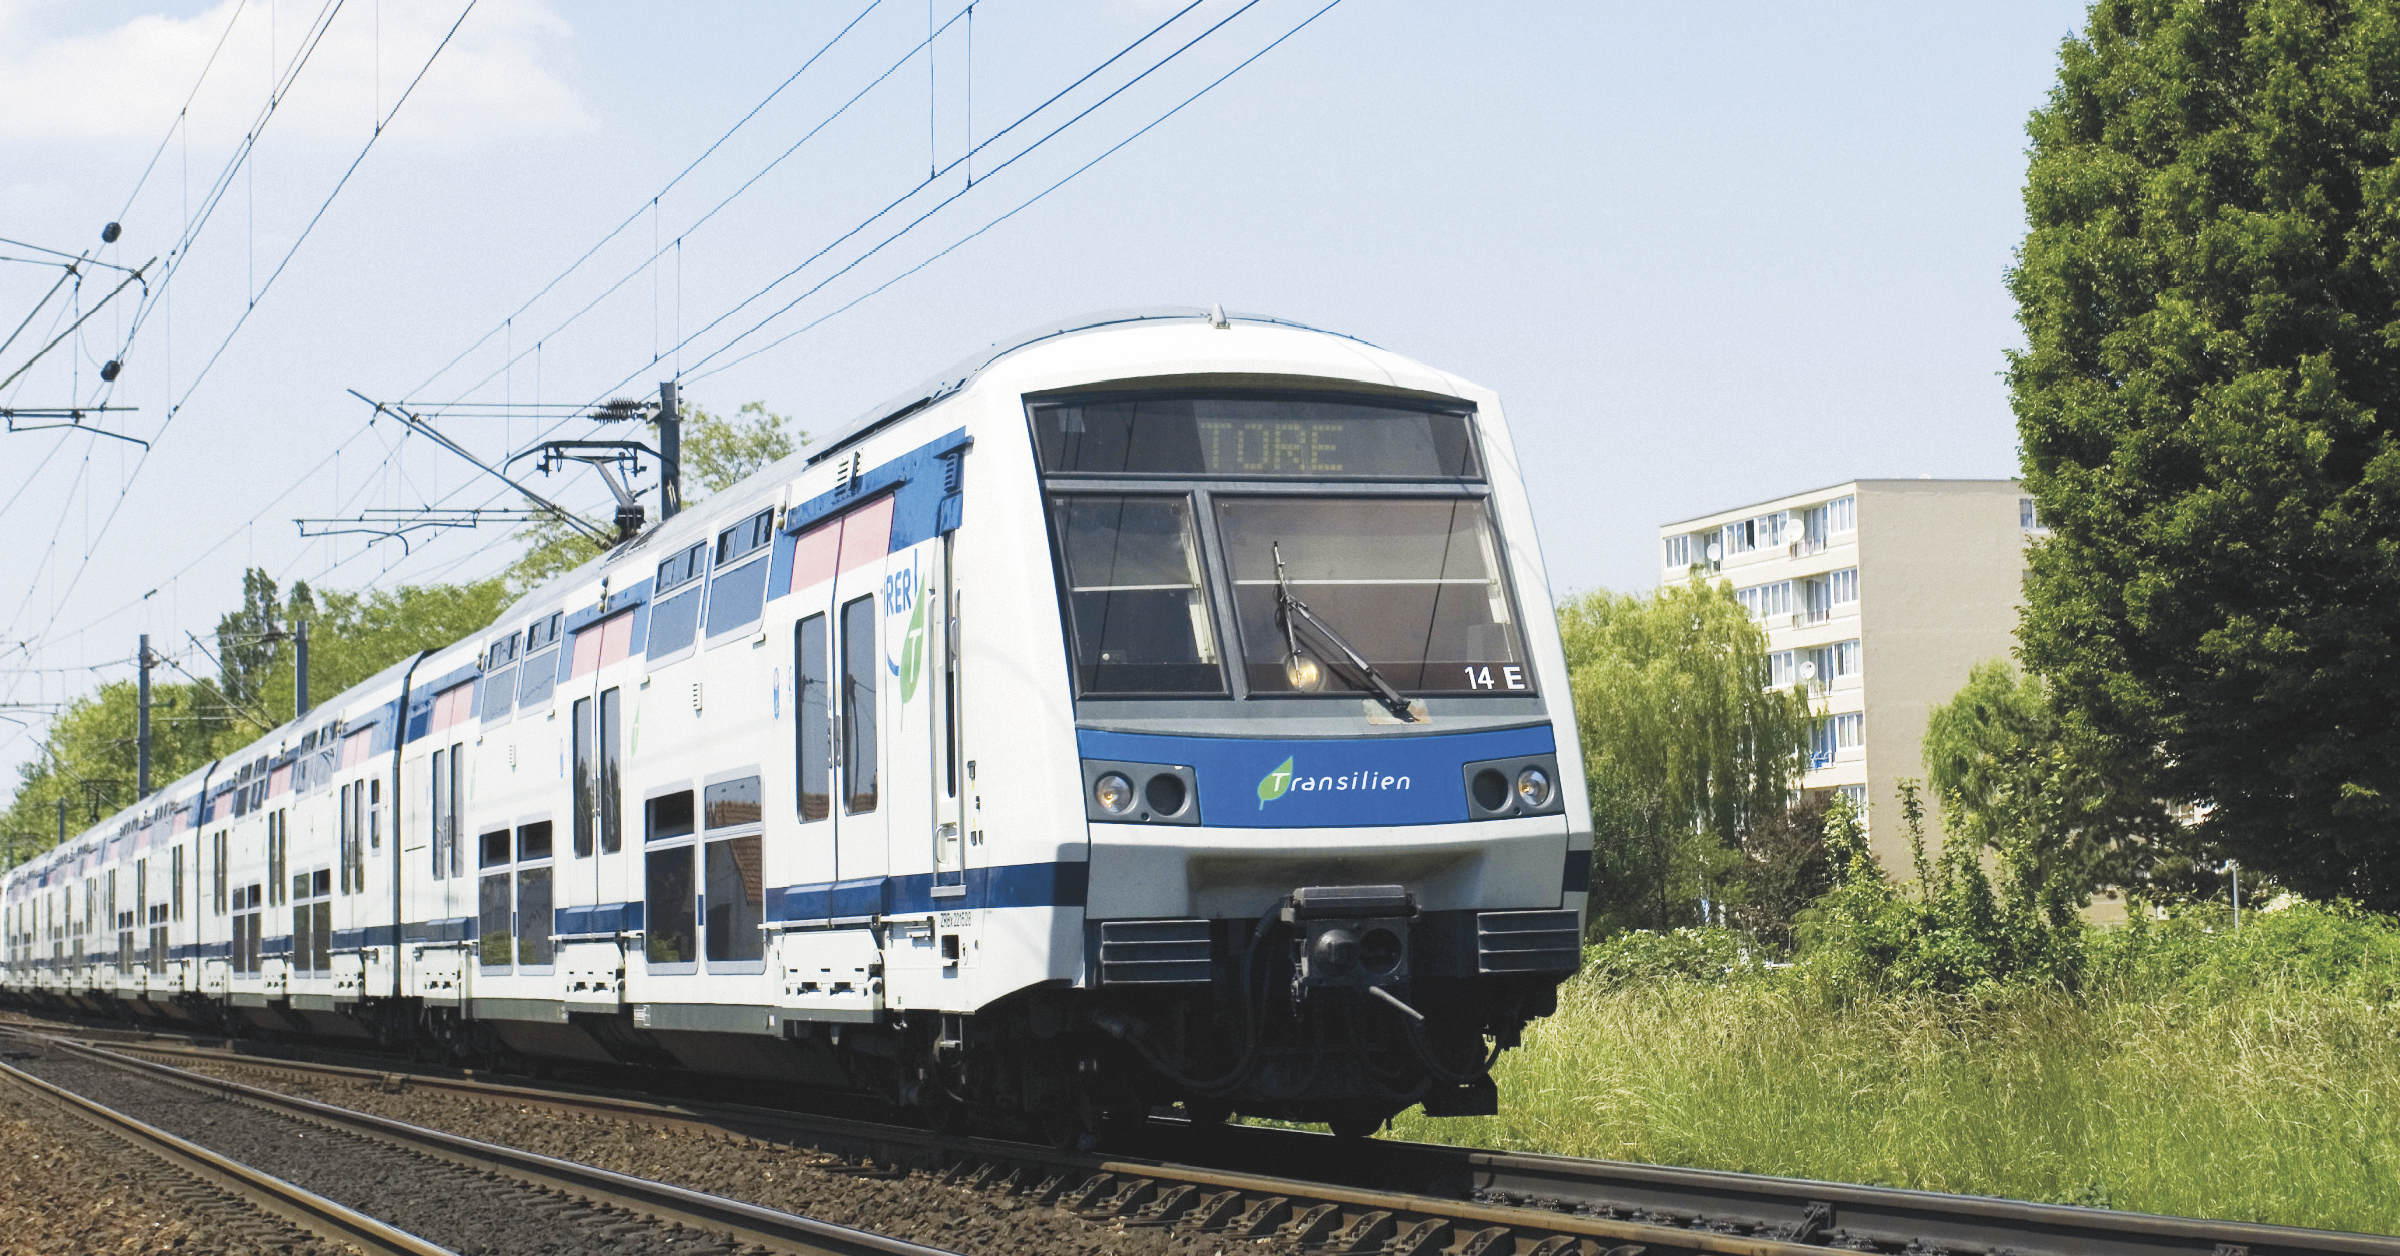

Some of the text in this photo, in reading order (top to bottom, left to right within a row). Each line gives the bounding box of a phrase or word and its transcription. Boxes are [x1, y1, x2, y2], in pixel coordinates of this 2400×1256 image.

[1200, 422, 1344, 471] TORE
[886, 567, 912, 618] RER
[1464, 666, 1526, 690] 14 E
[1271, 770, 1411, 793] Transilien
